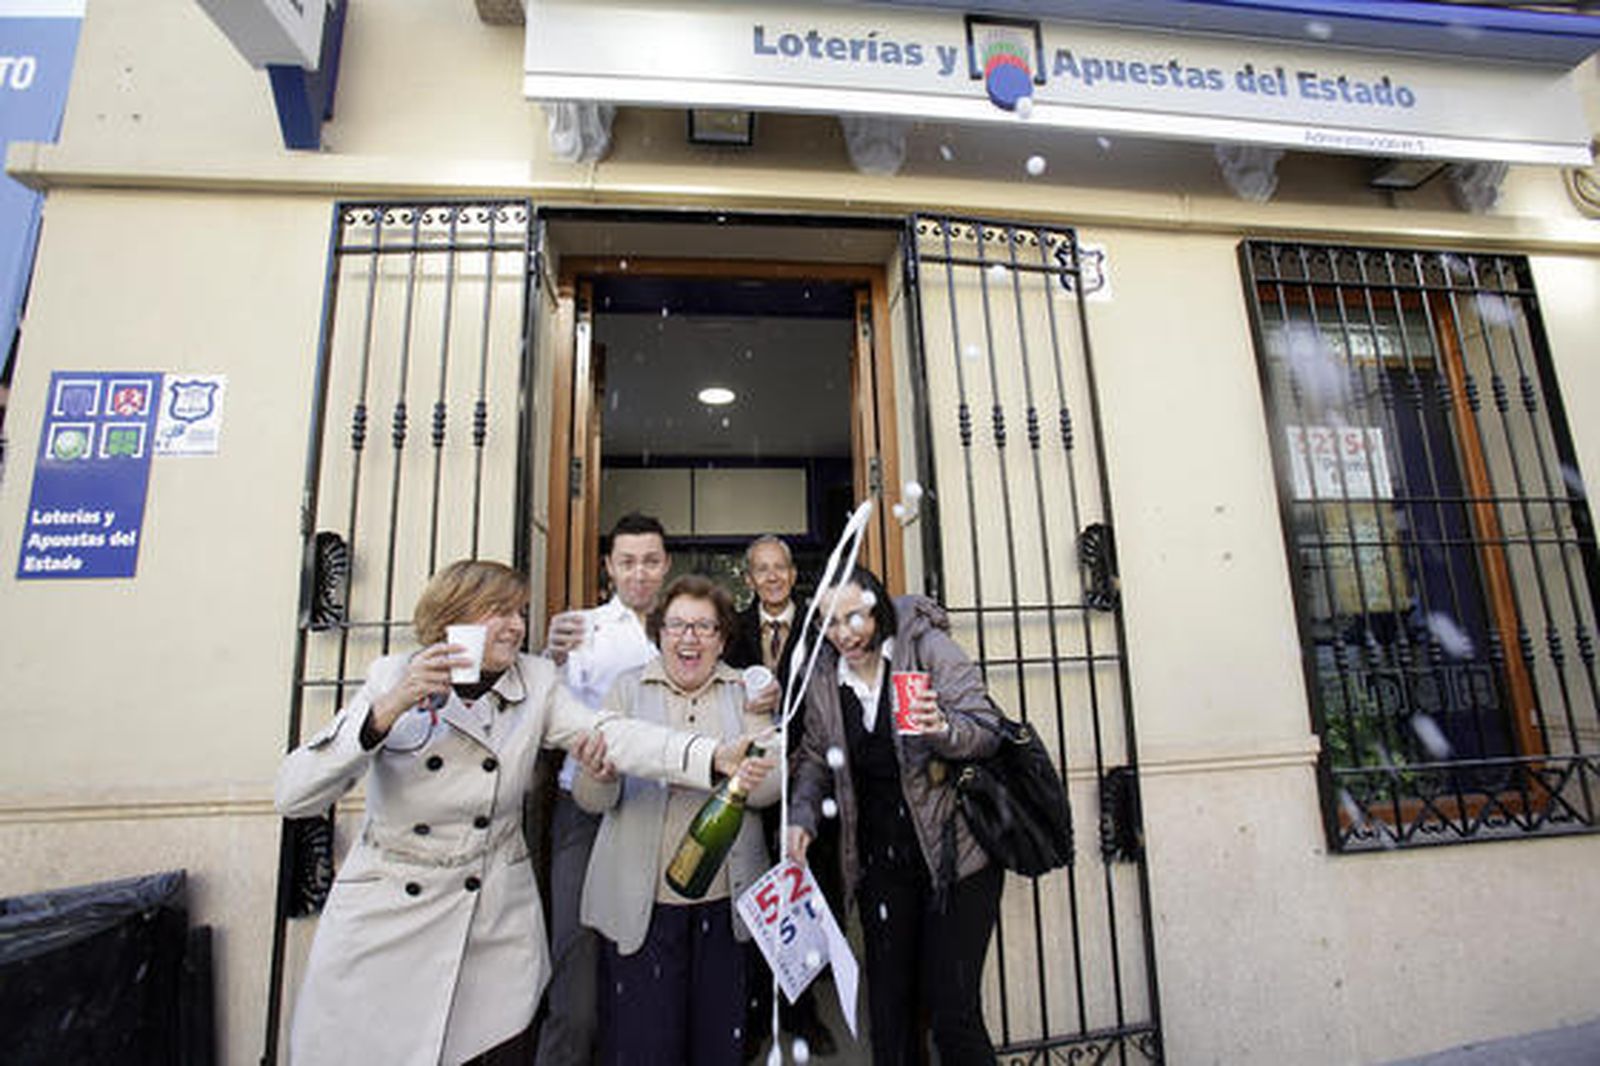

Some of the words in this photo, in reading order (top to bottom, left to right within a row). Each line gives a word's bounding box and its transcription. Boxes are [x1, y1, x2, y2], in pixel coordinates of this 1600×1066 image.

[753, 25, 924, 66] Loterías
[937, 45, 958, 76] y
[1053, 49, 1224, 91] Apuestas
[1235, 63, 1288, 97] del
[1298, 71, 1416, 107] Estado
[103, 512, 115, 527] y
[28, 533, 105, 552] Apuestas
[109, 530, 136, 546] del
[24, 554, 82, 571] Estado
[755, 867, 812, 925] 52
